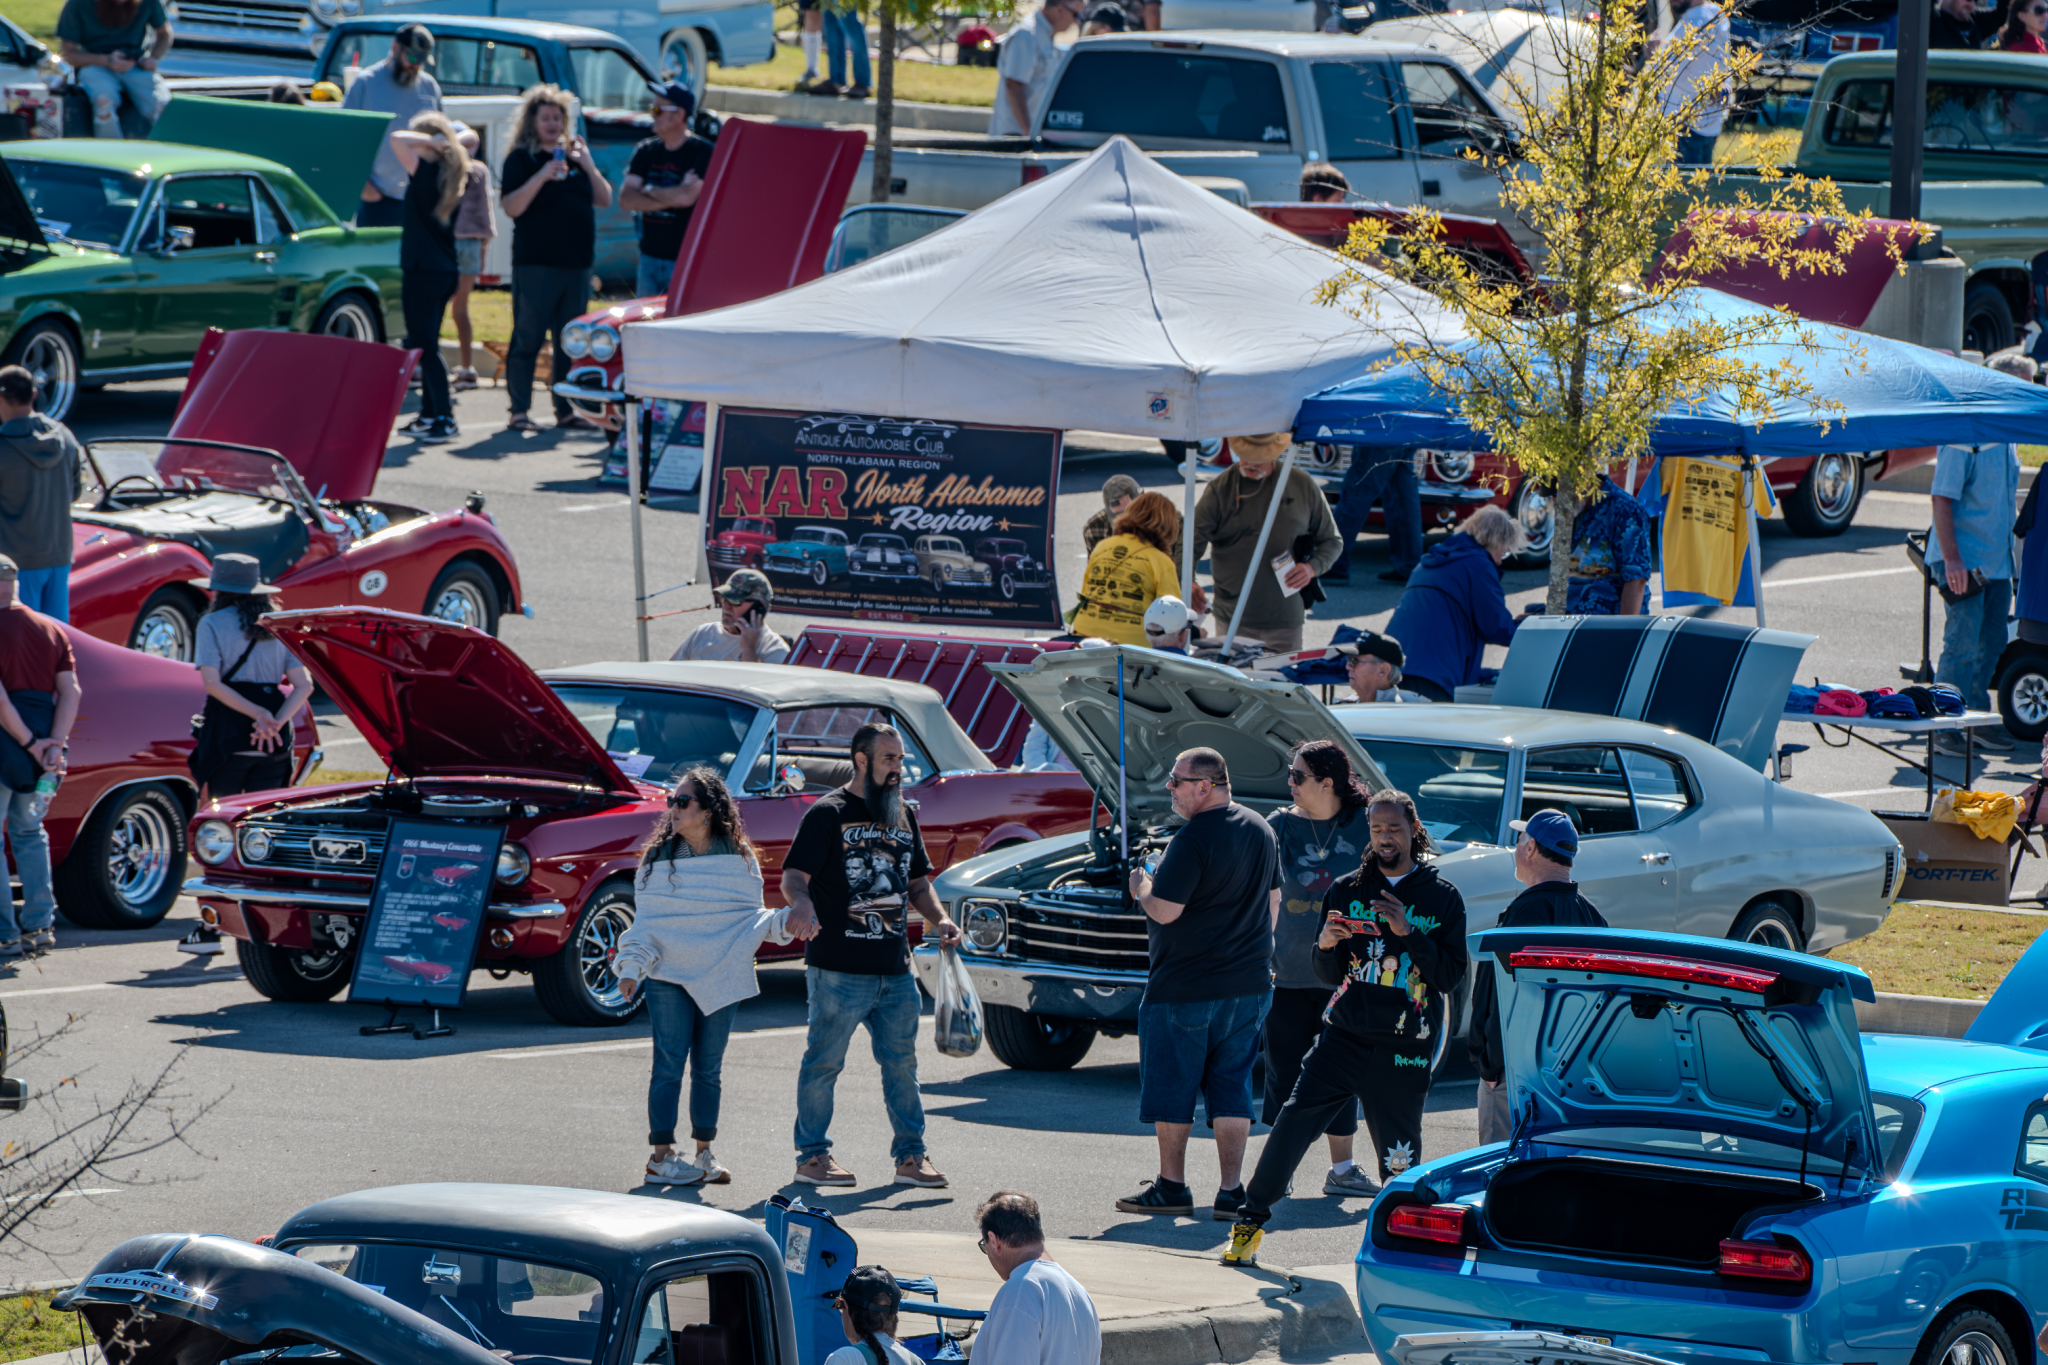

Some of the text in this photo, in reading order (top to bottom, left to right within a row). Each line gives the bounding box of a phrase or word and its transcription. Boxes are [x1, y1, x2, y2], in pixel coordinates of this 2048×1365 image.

[795, 430, 944, 454] ANTIQUE AUTOMOBILE CLUB
[807, 453, 940, 471] NORTH ALABAMA REGION
[718, 465, 849, 520] NAR
[853, 468, 1046, 510] North Alabama
[889, 505, 993, 534] Region
[826, 591, 851, 599] HISTORY
[1905, 867, 1999, 882] PORT-TEK
[104, 1277, 191, 1298] CHEVROLET
